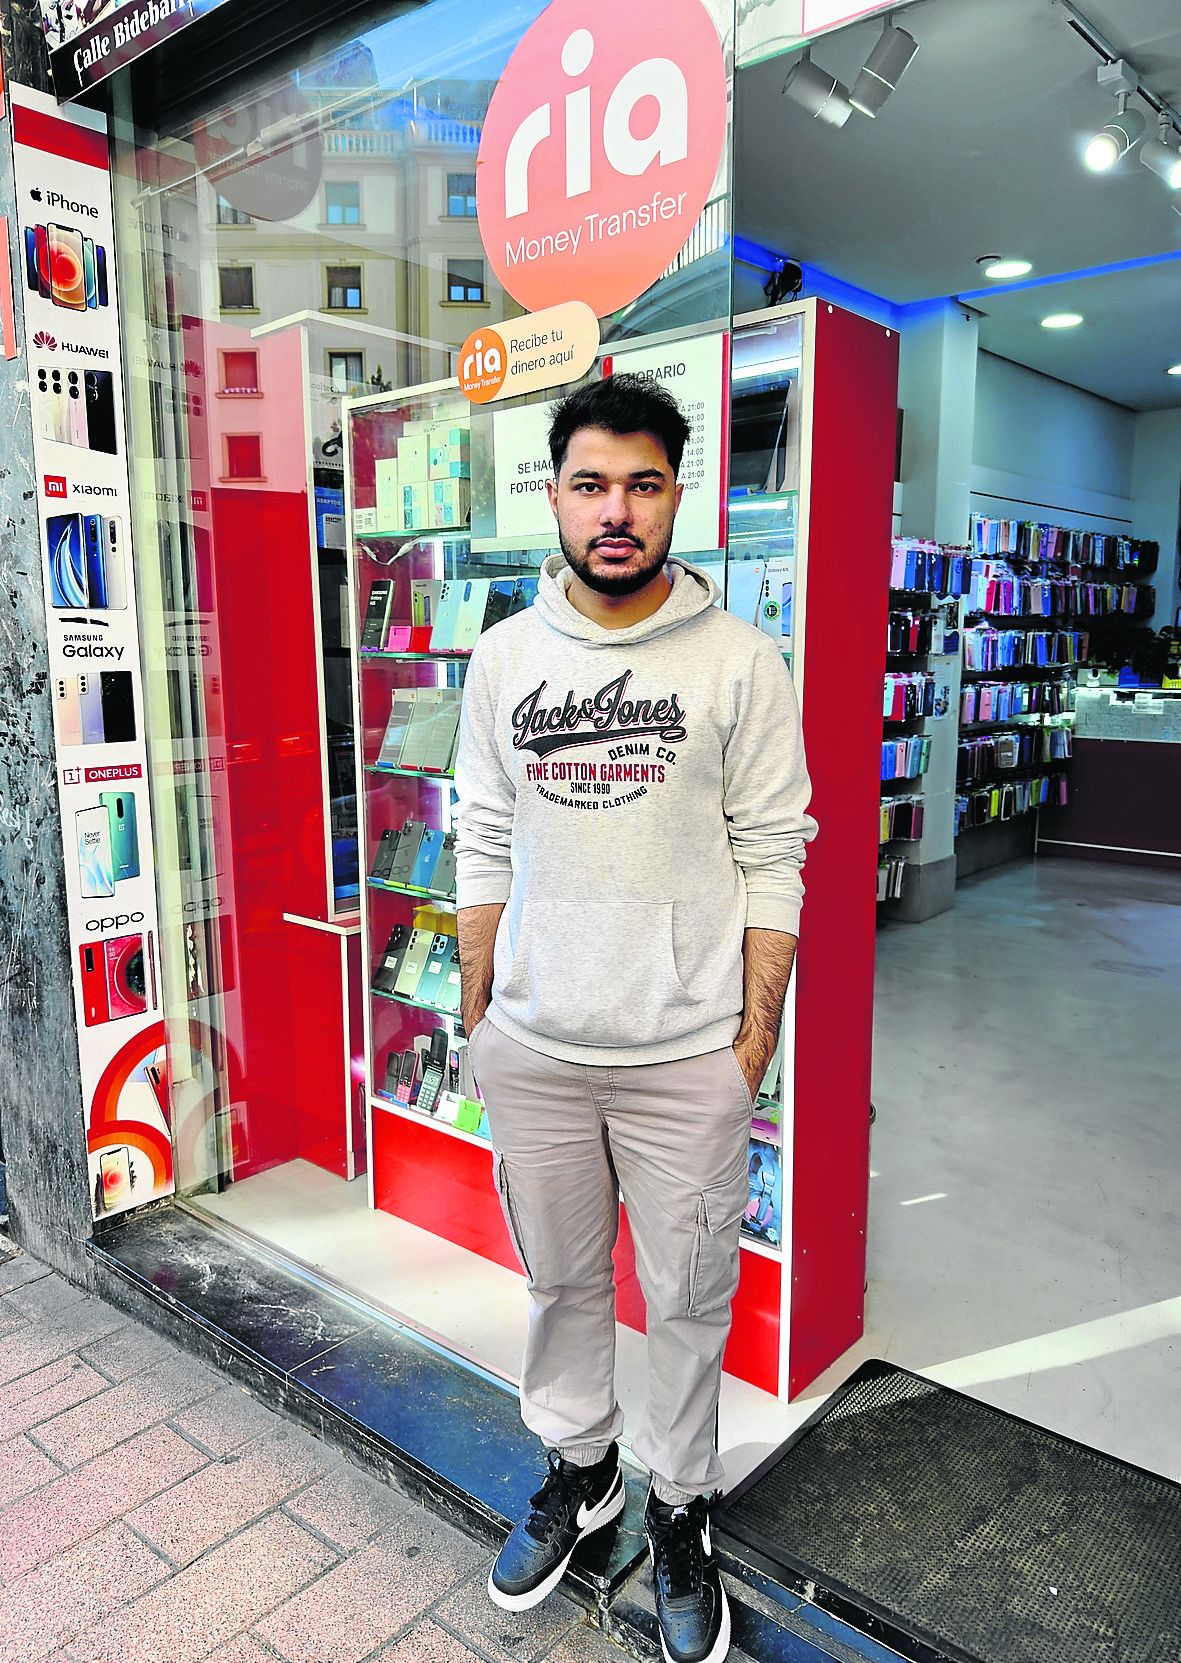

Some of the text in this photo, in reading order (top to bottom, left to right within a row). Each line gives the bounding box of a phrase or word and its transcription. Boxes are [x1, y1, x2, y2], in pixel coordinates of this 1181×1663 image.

[73, 35, 111, 87] Calle
[504, 28, 688, 219] ria
[46, 190, 98, 219] iPhone
[505, 191, 687, 268] Money Transfer
[61, 342, 109, 359] HUAWEI
[510, 329, 563, 353] Recibe tu
[463, 339, 501, 380] ria
[510, 344, 575, 375] dinero aquí
[463, 376, 501, 391] Money Transfer
[687, 402, 705, 412] 21:00
[688, 425, 705, 434] 1:00
[518, 462, 531, 474] SE
[686, 459, 704, 468] 21:00
[687, 469, 705, 479] 21:00
[63, 634, 104, 642] SAMSUNG
[62, 644, 125, 659] Galaxy
[608, 743, 677, 766] DENIM CO.
[88, 767, 139, 779] ONEPLUS
[526, 762, 665, 783] FINE COTTON GARMENTS
[535, 783, 648, 810] TRADEMARKED CLOTHING
[570, 782, 611, 795] SINCE 1990
[85, 911, 145, 932] oppo
